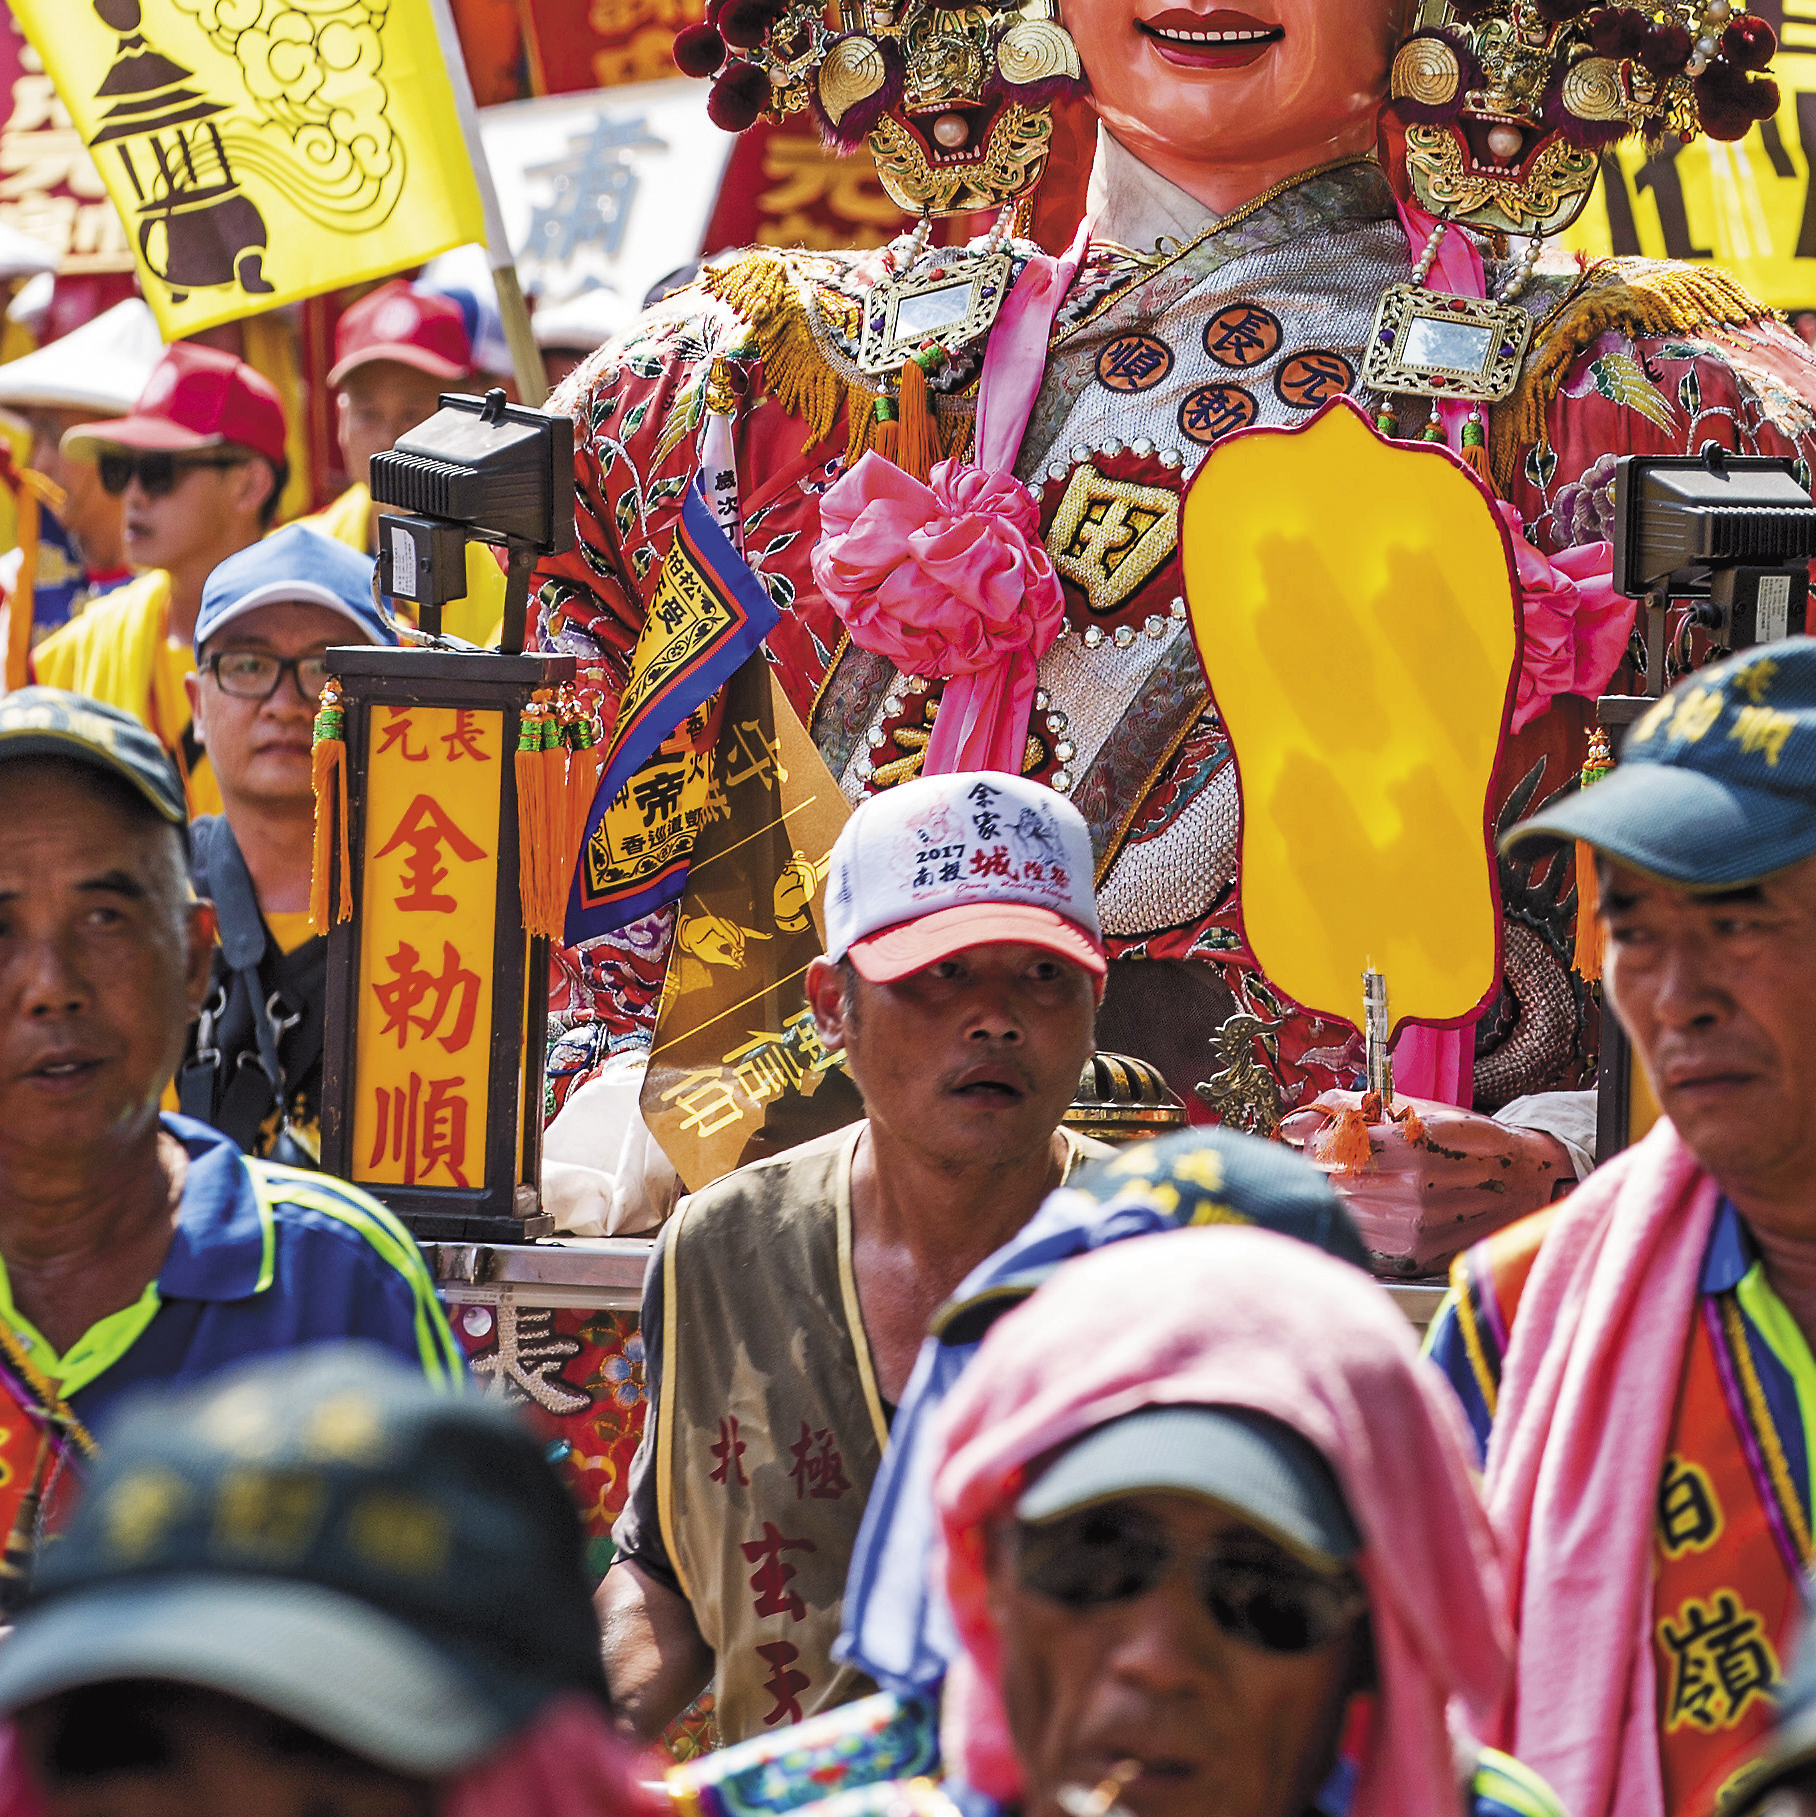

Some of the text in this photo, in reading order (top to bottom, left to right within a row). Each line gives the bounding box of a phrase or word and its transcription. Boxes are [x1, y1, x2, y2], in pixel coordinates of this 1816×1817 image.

[915, 843, 967, 865] 2017
[369, 792, 488, 1188] 金勅順
[708, 1414, 853, 1500] 北極
